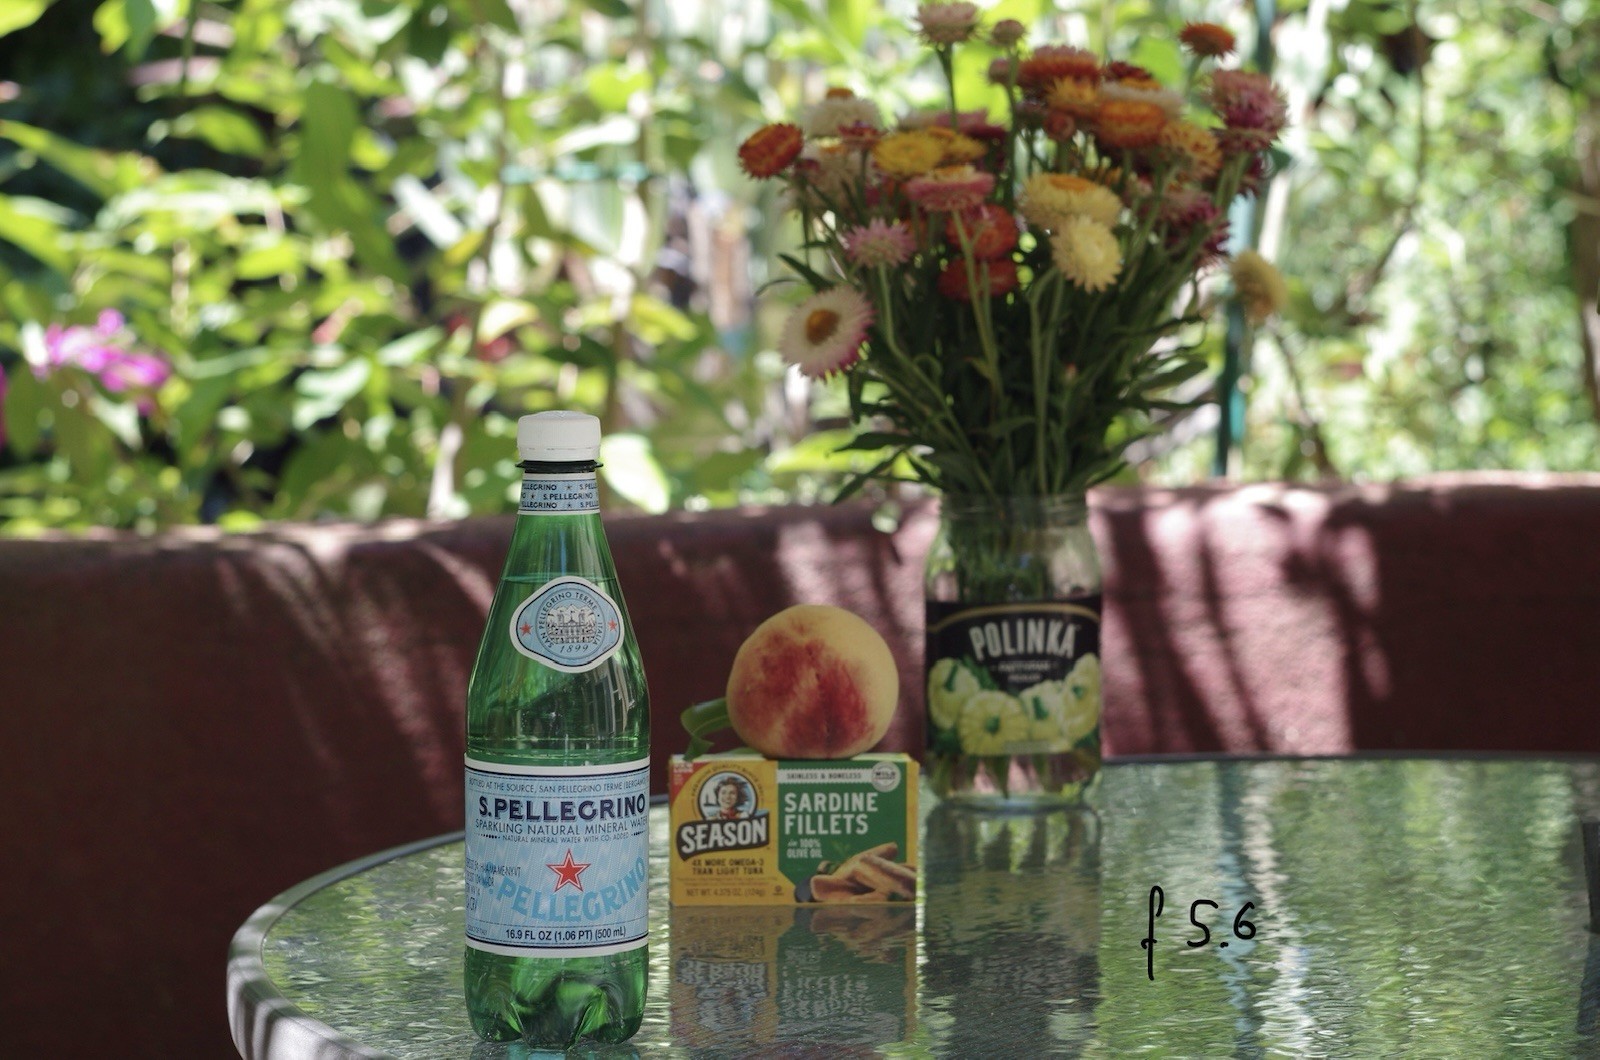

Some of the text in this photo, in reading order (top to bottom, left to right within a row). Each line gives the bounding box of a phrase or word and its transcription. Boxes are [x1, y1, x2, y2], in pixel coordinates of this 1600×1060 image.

[543, 492, 593, 500] S.PELLEGRINO
[538, 591, 598, 649] SAN PELLEGRINO TERME
[559, 644, 590, 654] 1899
[969, 617, 1077, 662] POLINKA
[494, 782, 505, 791] THE
[539, 785, 556, 793] SAN
[557, 783, 602, 794] PELLEGRINO
[603, 781, 623, 792] TERME
[479, 794, 646, 823] S.PELLEGRINO
[783, 792, 879, 813] SARDINE
[475, 816, 648, 836] SPARKLING NATURAL MINERAL WATER
[783, 814, 869, 836] FILLETS
[502, 834, 529, 843] NATURAL
[530, 836, 559, 844] MINERAL
[561, 836, 582, 844] WATER
[612, 832, 629, 841] ADDED
[680, 816, 768, 855] SEASON
[692, 867, 713, 875] THAN
[743, 867, 764, 875] TUNA
[505, 929, 522, 940] 16.9
[524, 931, 536, 941] FL
[538, 930, 552, 941] OZ
[554, 930, 576, 942] (1.06
[578, 929, 593, 941] PT)
[595, 928, 612, 940] (500
